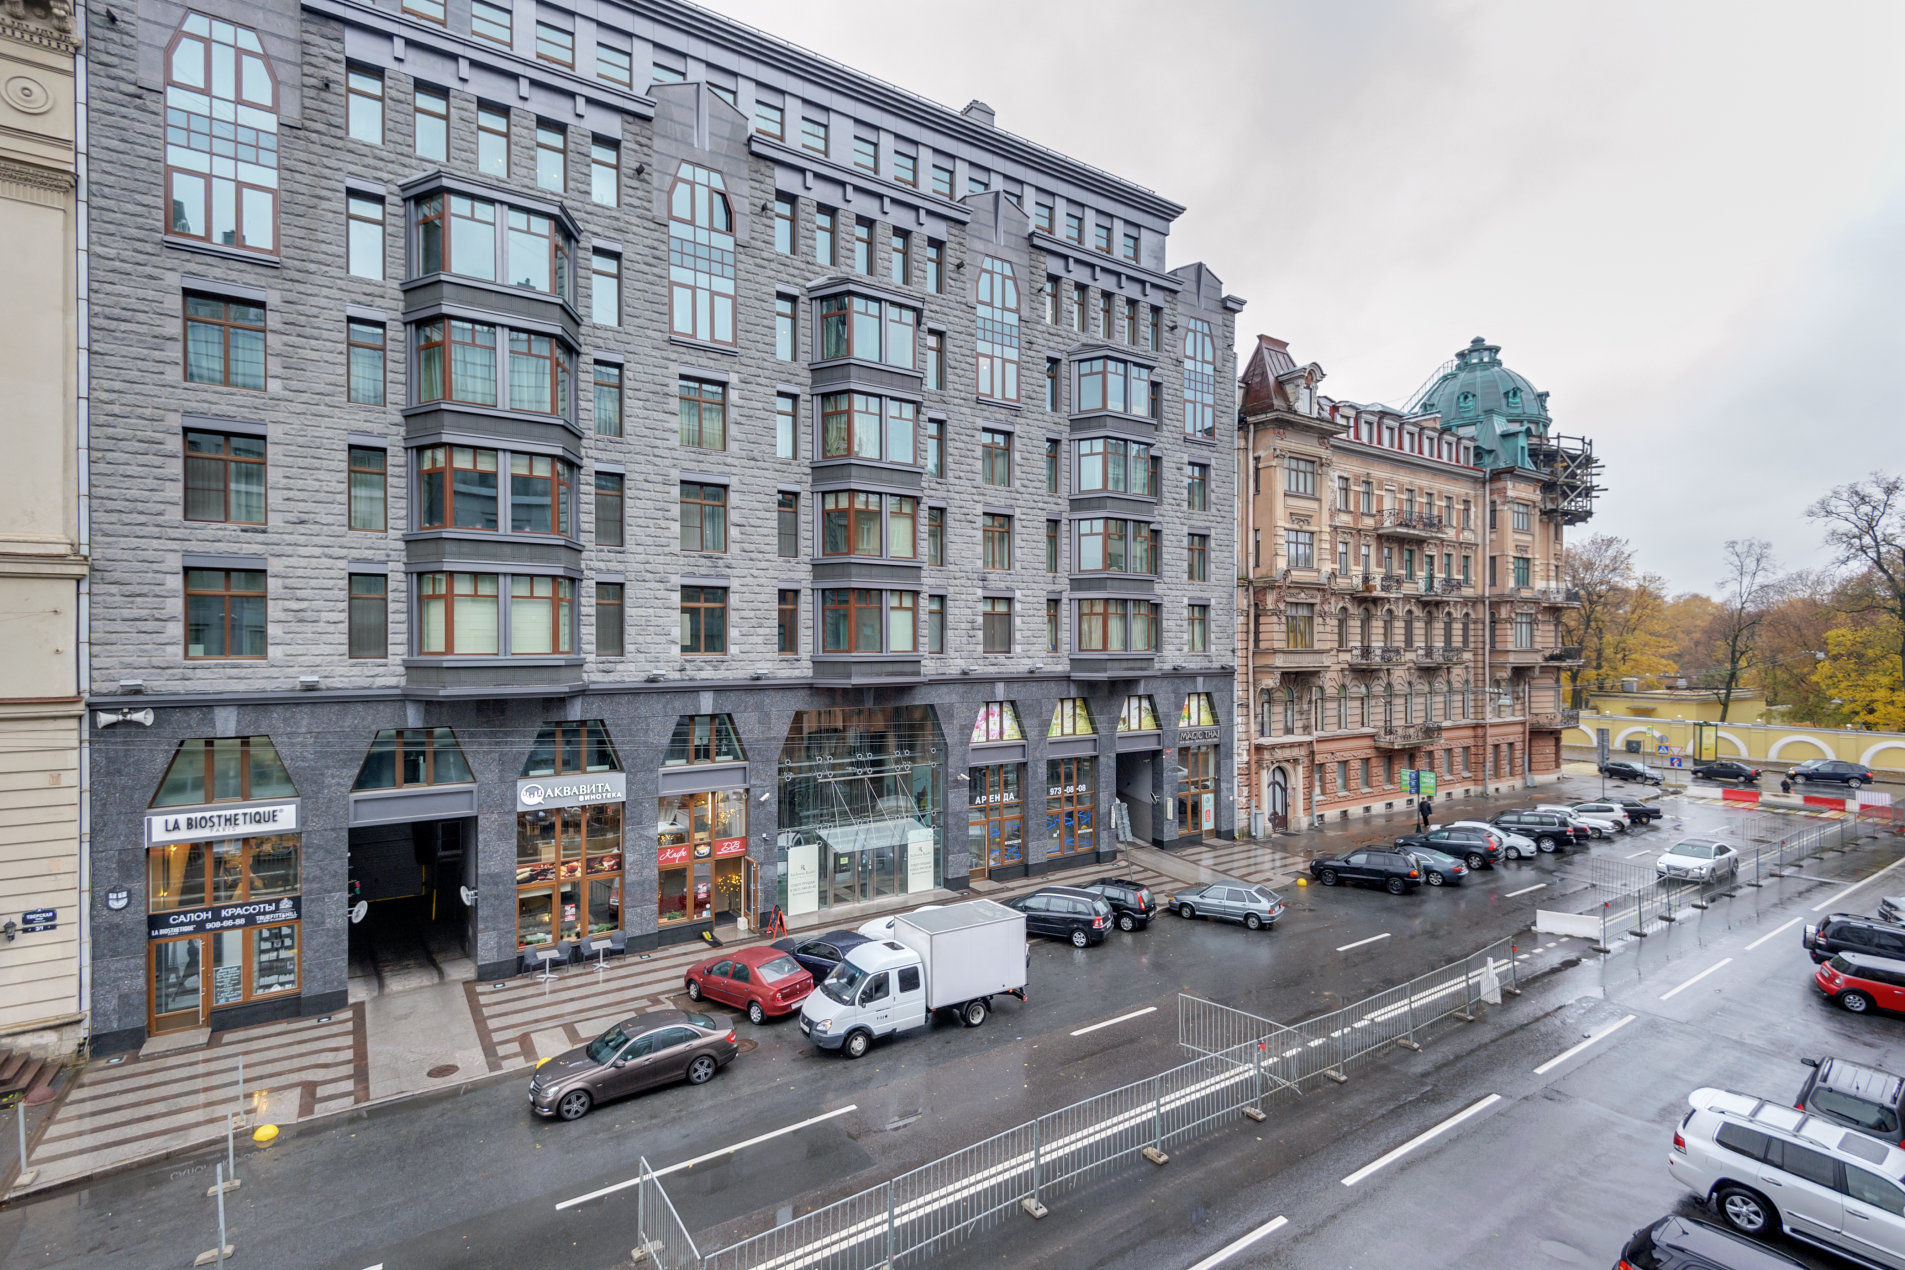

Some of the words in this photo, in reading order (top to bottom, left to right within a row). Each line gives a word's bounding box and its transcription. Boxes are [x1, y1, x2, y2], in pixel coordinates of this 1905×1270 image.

[545, 783, 611, 798] АКВАВИТА
[579, 792, 622, 802] ВИНОТЕКА
[975, 792, 1015, 805] АРЕНДА
[164, 818, 180, 832] LA
[186, 809, 279, 830] BIOSTHETIQUE
[169, 911, 212, 924] САЛОН
[221, 902, 276, 918] КРАСОТЫ
